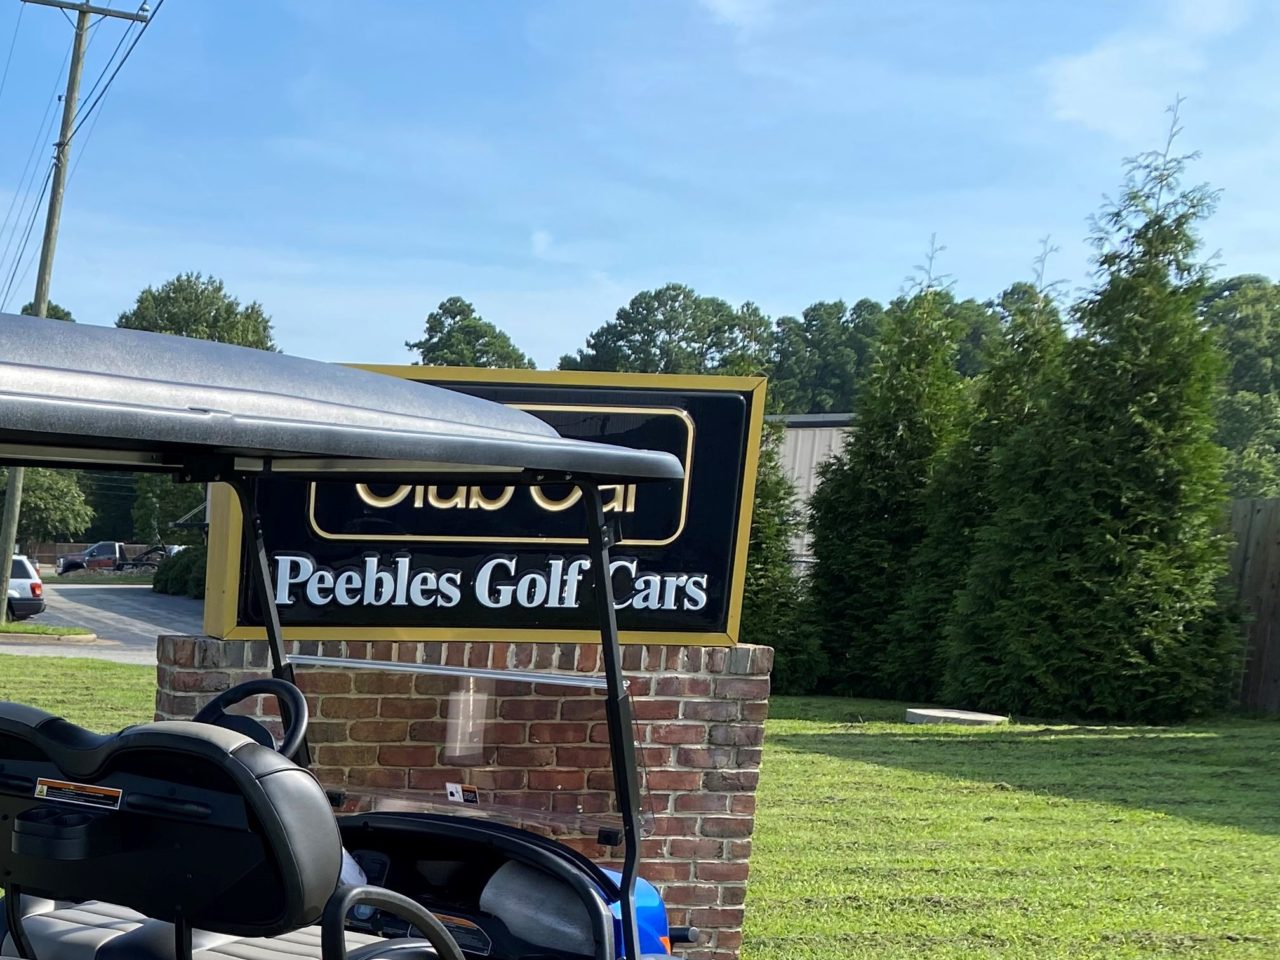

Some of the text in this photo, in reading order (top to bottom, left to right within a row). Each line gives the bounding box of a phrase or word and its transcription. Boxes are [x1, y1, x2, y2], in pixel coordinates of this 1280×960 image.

[273, 555, 708, 612] Peebles Golf Cars
